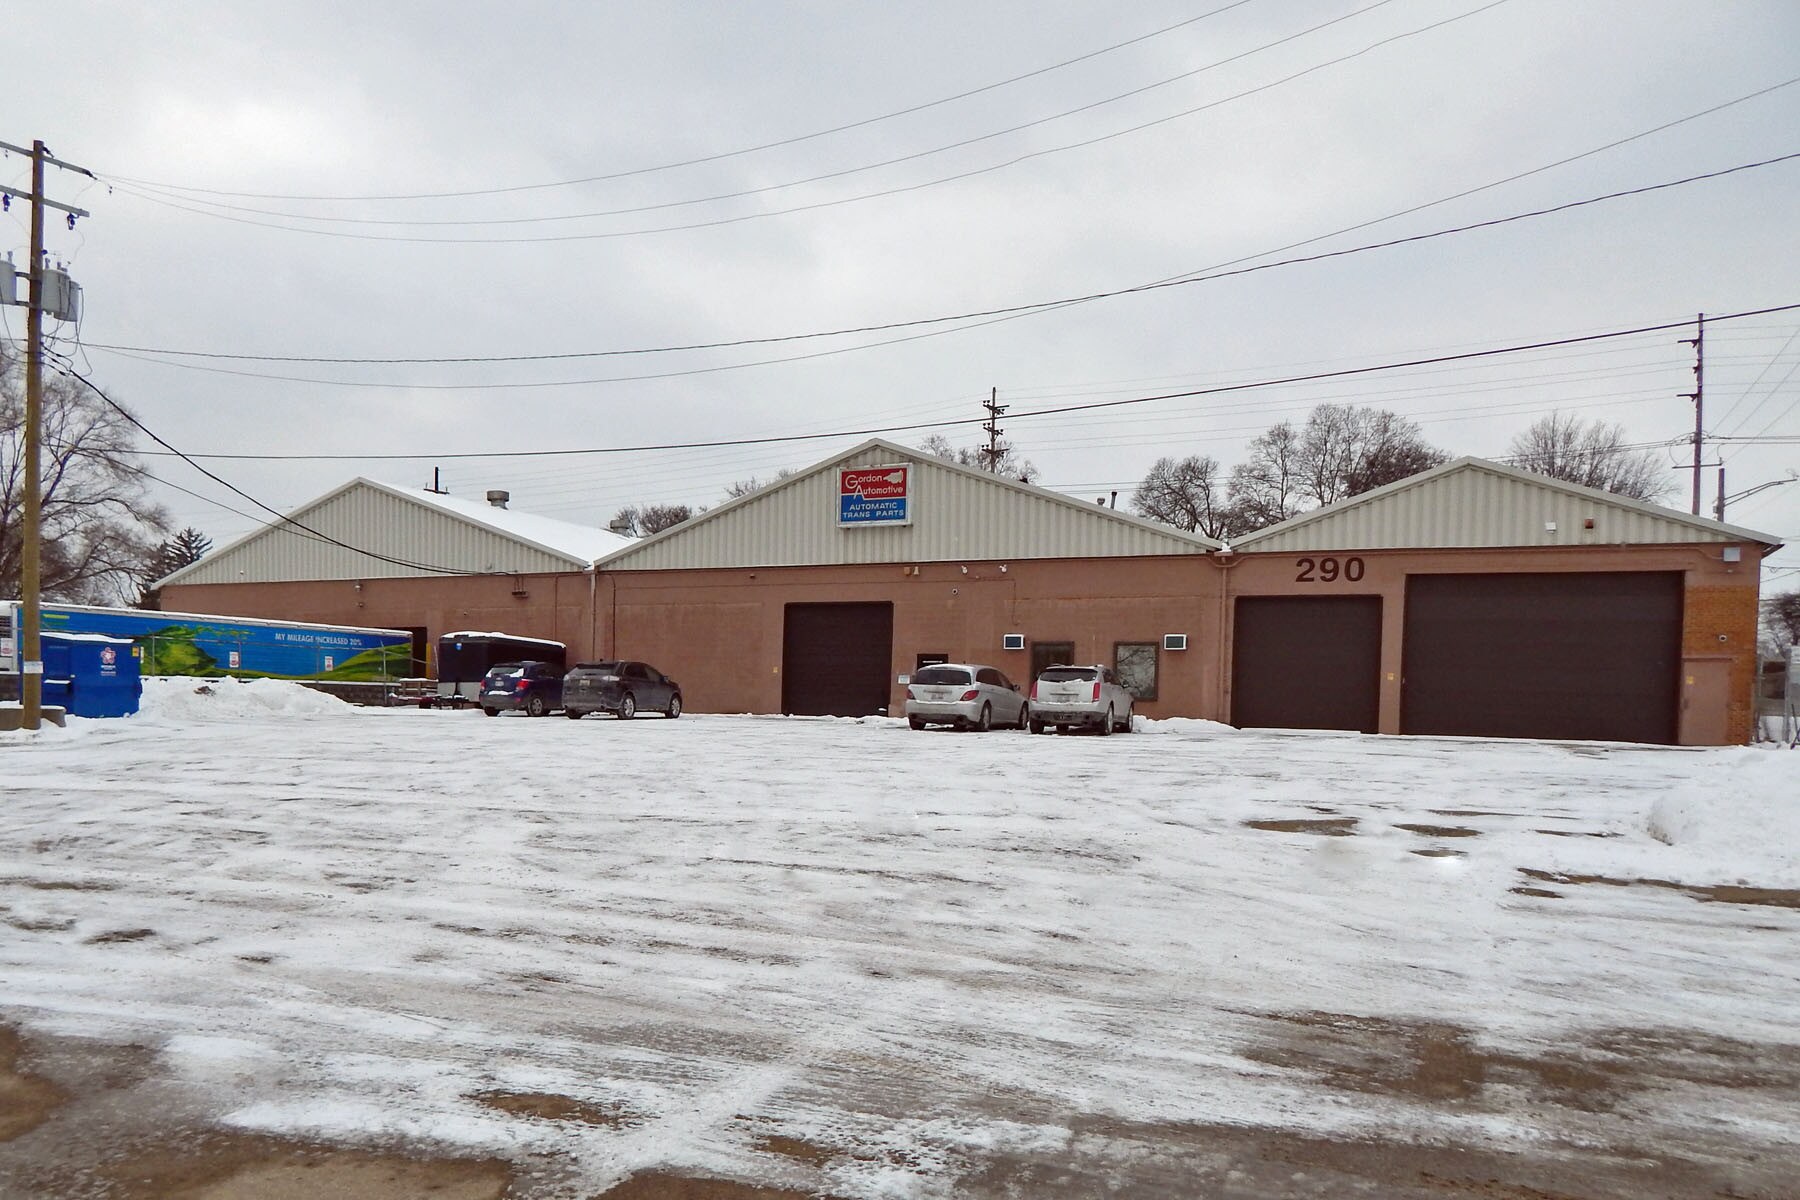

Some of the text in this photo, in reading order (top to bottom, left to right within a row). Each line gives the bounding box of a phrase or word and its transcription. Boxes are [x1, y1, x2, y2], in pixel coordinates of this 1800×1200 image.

[845, 474, 882, 489] Gordon
[854, 485, 904, 500] Automotive
[849, 502, 897, 511] AUTOMATIC
[1296, 557, 1364, 582] 290
[287, 634, 313, 642] MILEAGE
